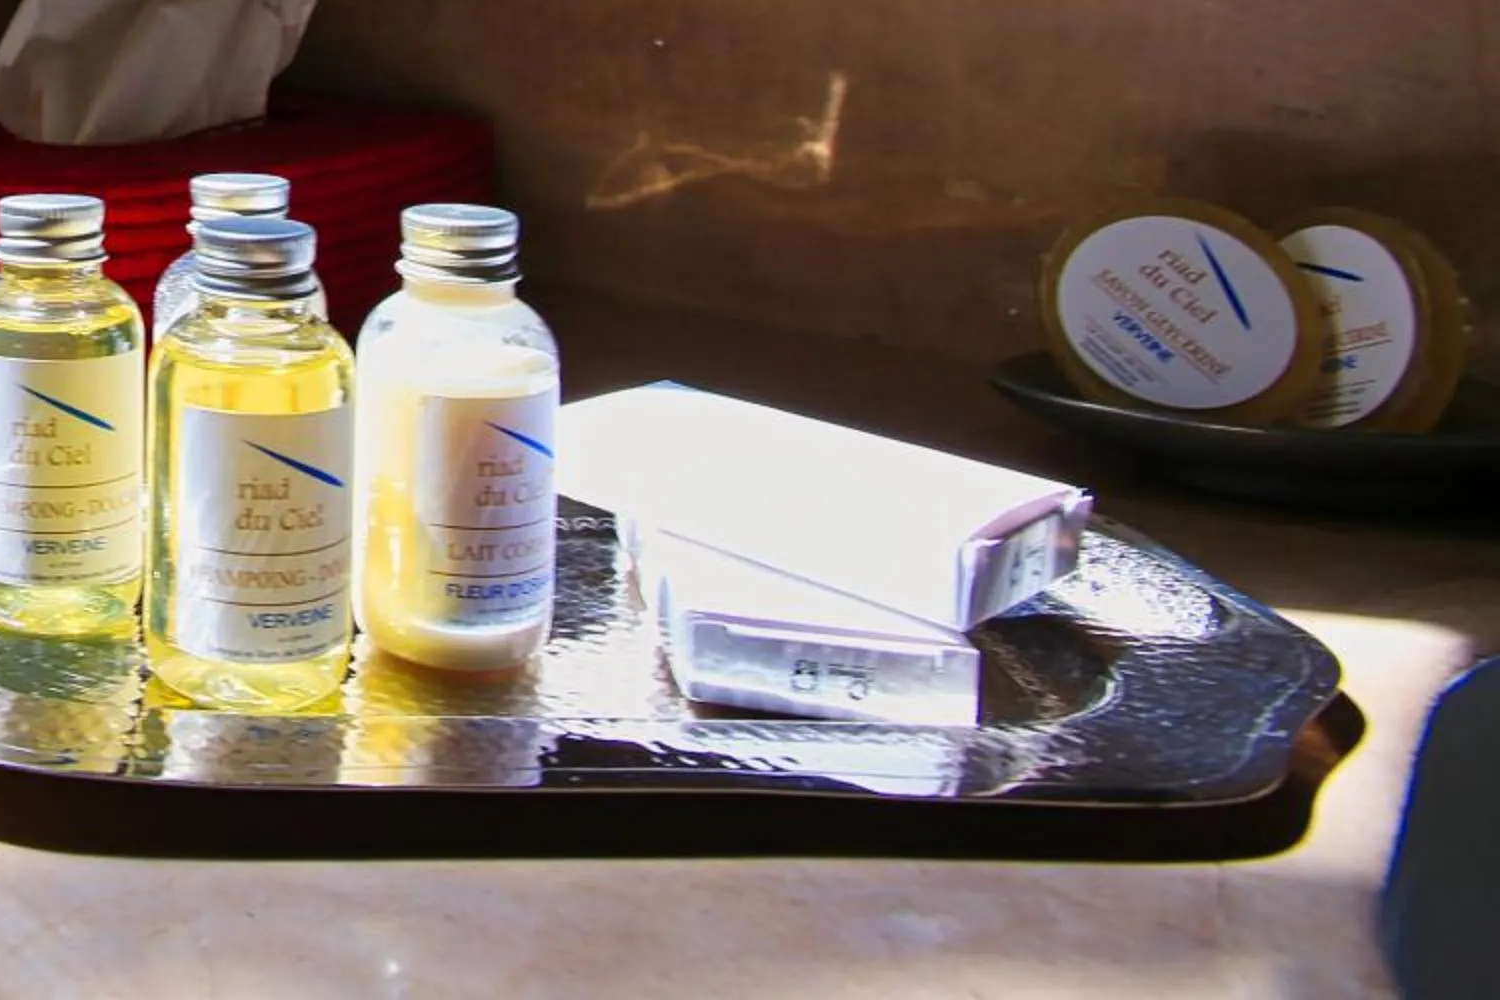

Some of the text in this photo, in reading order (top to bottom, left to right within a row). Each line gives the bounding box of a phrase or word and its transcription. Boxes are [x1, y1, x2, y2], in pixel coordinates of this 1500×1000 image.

[1156, 248, 1208, 285] riad
[1138, 264, 1219, 324] du Ciel
[11, 416, 58, 438] riad
[9, 442, 92, 466] du Ciel
[477, 453, 524, 478] riad
[237, 476, 291, 501] riad
[474, 484, 507, 508] du
[234, 502, 325, 531] du Ciel
[22, 534, 109, 556] VERVEINE
[447, 540, 499, 562] LAIT
[445, 581, 505, 600] FLEUR
[248, 602, 334, 629] VERVEINE
